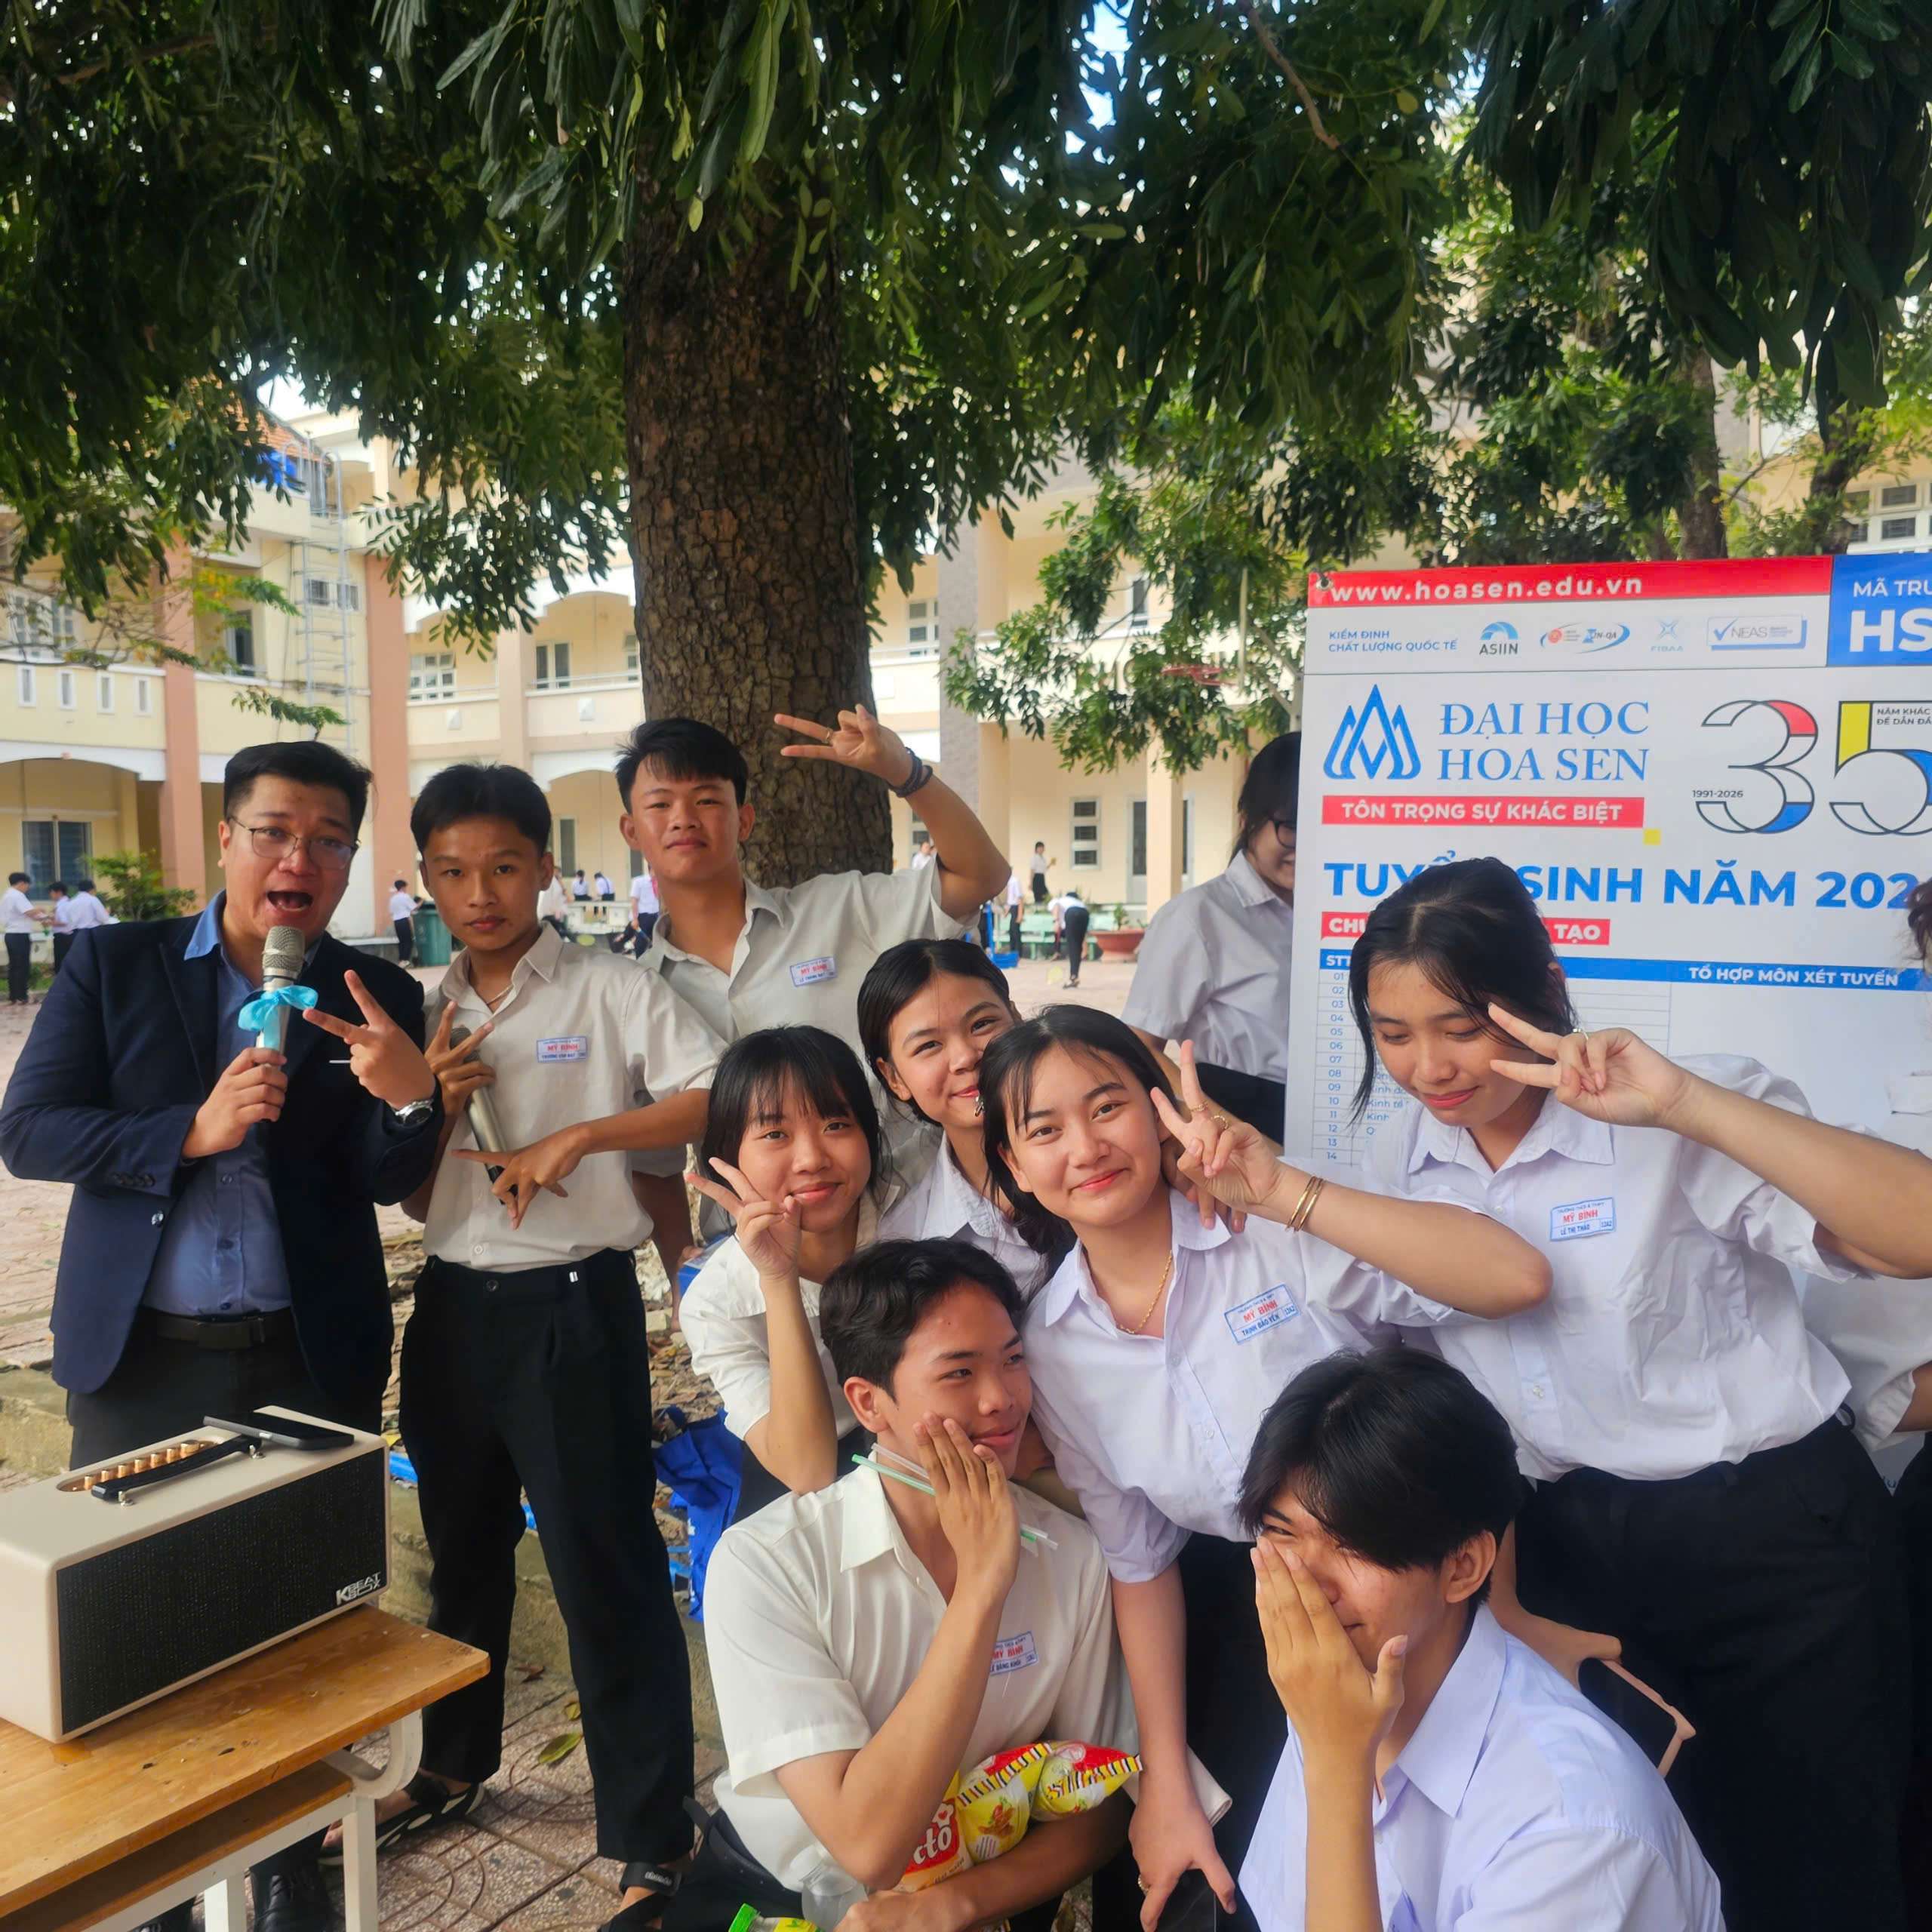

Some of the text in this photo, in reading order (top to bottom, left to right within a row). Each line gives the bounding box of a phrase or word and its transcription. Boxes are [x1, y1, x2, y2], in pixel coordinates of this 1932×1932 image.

[1331, 577, 1642, 601] www.hoasen.edu.vn
[1853, 577, 1888, 597] MÃ
[1443, 638, 1459, 650] TẾ
[1479, 643, 1518, 655] ASIIN
[1439, 702, 1650, 740] ĐẠI HỌC
[1438, 747, 1650, 781] HOA SEN
[1692, 789, 1744, 798] 1991-2026
[1342, 800, 1623, 824] TÔN TRỌNG SỰ KHÁC BIỆT
[1519, 865, 1643, 903] SINH
[1664, 860, 1797, 907] NĂM
[1815, 871, 1921, 909] 202
[1554, 923, 1601, 943] TẠO
[1334, 972, 1344, 980] 01
[1689, 965, 1900, 986] TỔ HỢP MÔN XÉT TUYỂN
[1332, 986, 1344, 995] 02
[1331, 1000, 1344, 1008] 03
[1331, 1014, 1343, 1022] 04
[1330, 1028, 1343, 1036] 05
[1330, 1041, 1343, 1050] 06
[1328, 1069, 1341, 1078] 08
[1328, 1083, 1341, 1091] 09
[1329, 1097, 1340, 1105] 10
[1328, 1124, 1338, 1133] 12
[1328, 1138, 1337, 1146] 13
[1327, 1152, 1337, 1160] 14
[1563, 1209, 1598, 1223] MỸ BÌNH
[1257, 1300, 1278, 1315] BÌNH
